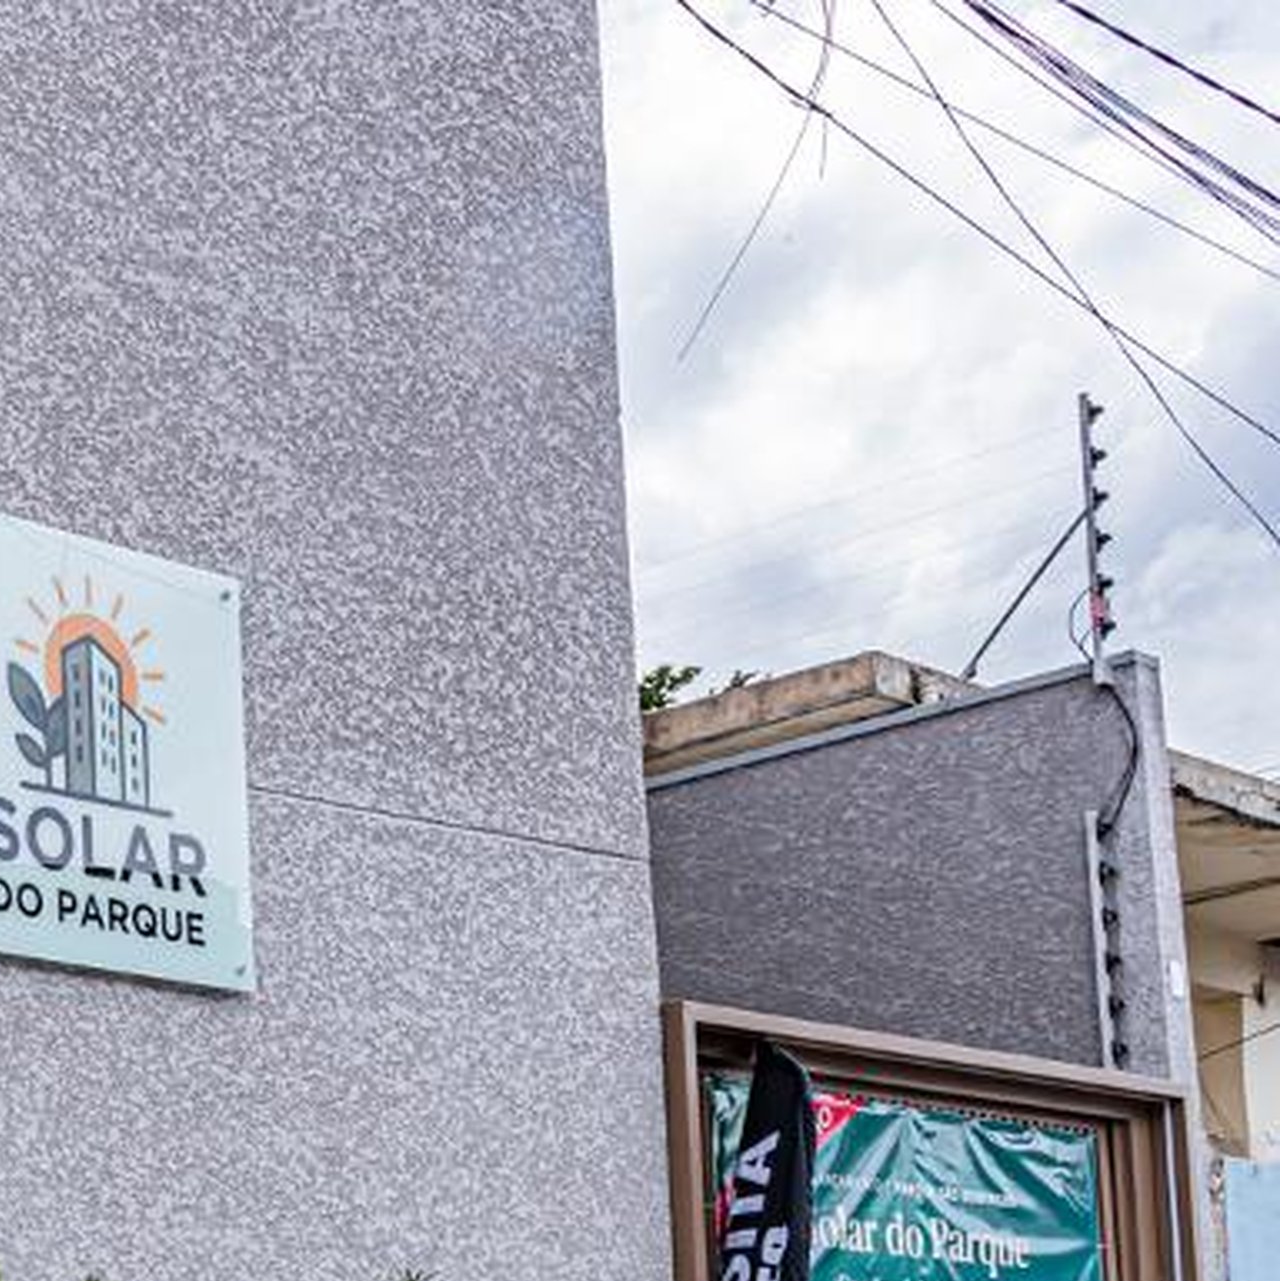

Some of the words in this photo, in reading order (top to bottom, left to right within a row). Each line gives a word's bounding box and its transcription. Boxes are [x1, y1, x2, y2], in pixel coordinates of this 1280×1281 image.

[57, 889, 205, 947] PARQUE
[811, 1205, 877, 1253] olar
[885, 1210, 924, 1258] do
[931, 1217, 1030, 1279] Parque
